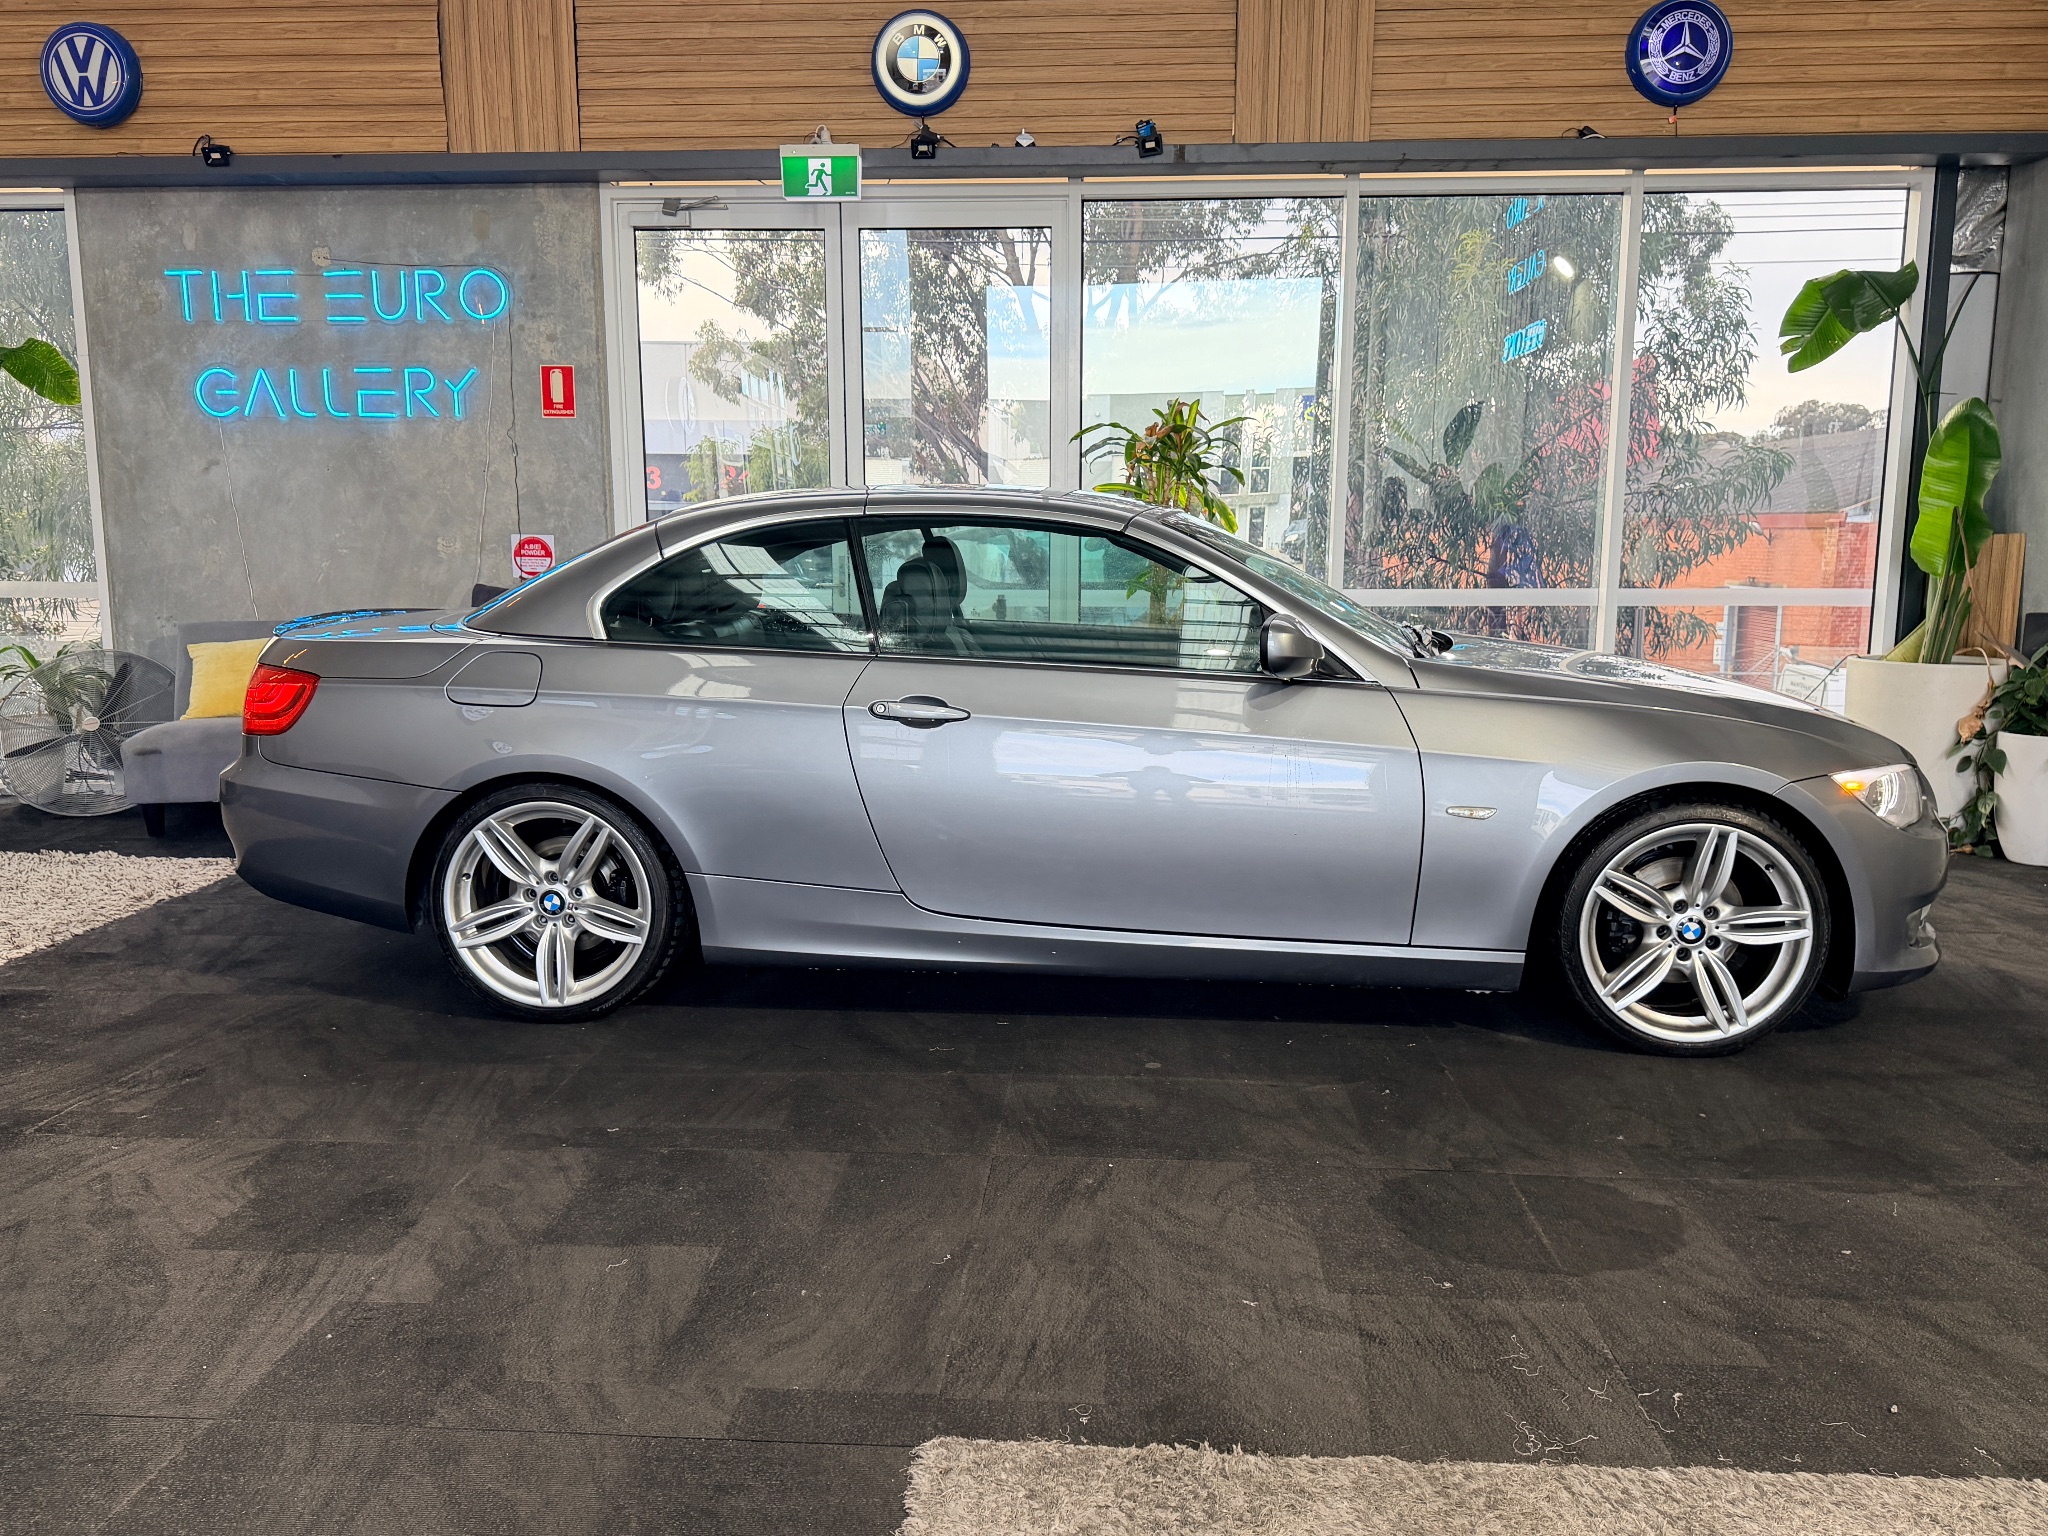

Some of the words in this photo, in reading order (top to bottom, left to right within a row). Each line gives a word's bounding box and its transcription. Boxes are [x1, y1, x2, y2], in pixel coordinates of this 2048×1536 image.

[1660, 11, 1711, 30] MERCEDES
[892, 24, 947, 48] BMW
[1668, 70, 1696, 82] BENZ
[164, 269, 299, 322] THE
[322, 268, 509, 322] EURO
[195, 366, 479, 419] GALLERY
